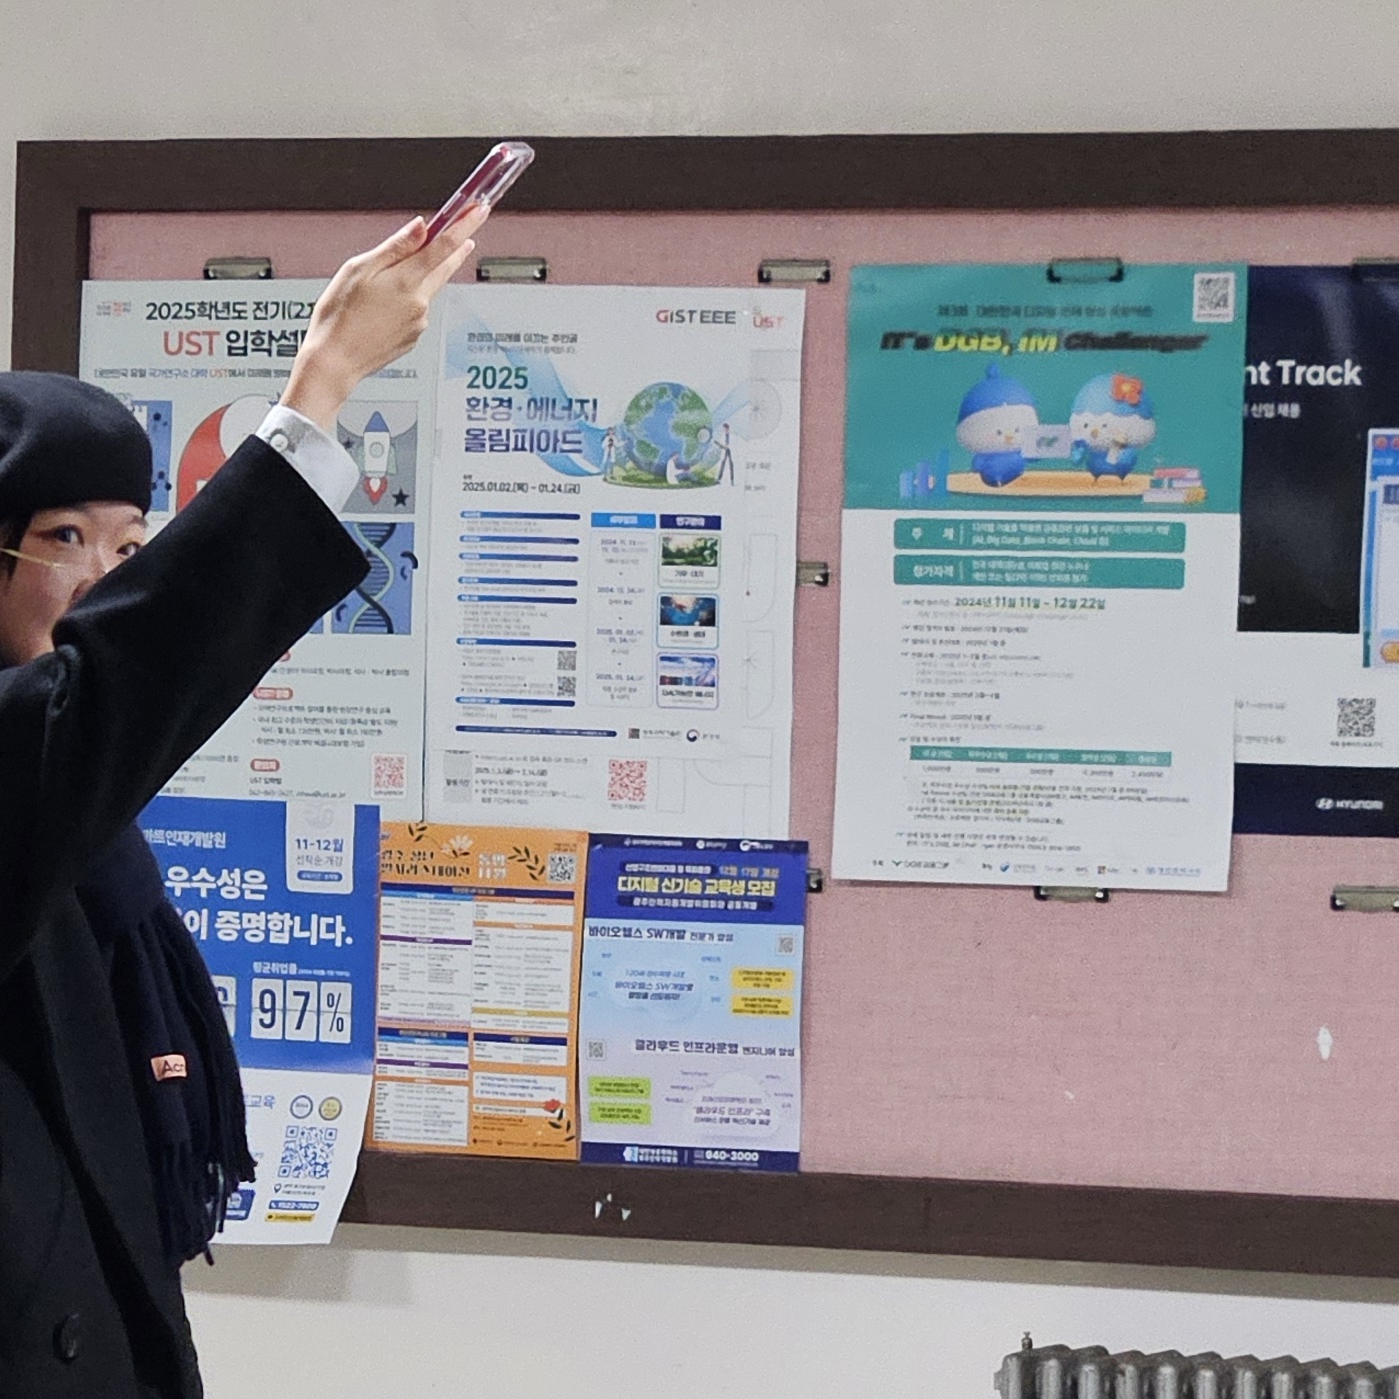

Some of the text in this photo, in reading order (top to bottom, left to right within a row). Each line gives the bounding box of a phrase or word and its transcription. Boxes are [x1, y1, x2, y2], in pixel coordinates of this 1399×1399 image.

[145, 301, 248, 321] 2025학년도
[163, 330, 307, 357] UST 입학설
[466, 366, 528, 390] 2025
[1276, 359, 1363, 386] Track
[1251, 403, 1301, 418] 신입 채용
[464, 428, 583, 453] 올림피아드
[955, 597, 992, 608] 2024년
[295, 838, 344, 852] 11-12월
[165, 866, 268, 900] 우수성은
[617, 876, 776, 897] 디지털 신기술 교육생 모집
[177, 908, 353, 947] 이 증명합니다.
[589, 926, 643, 939] 바이오헬스
[646, 928, 686, 940] SW개발
[635, 1038, 679, 1052] 클라우드
